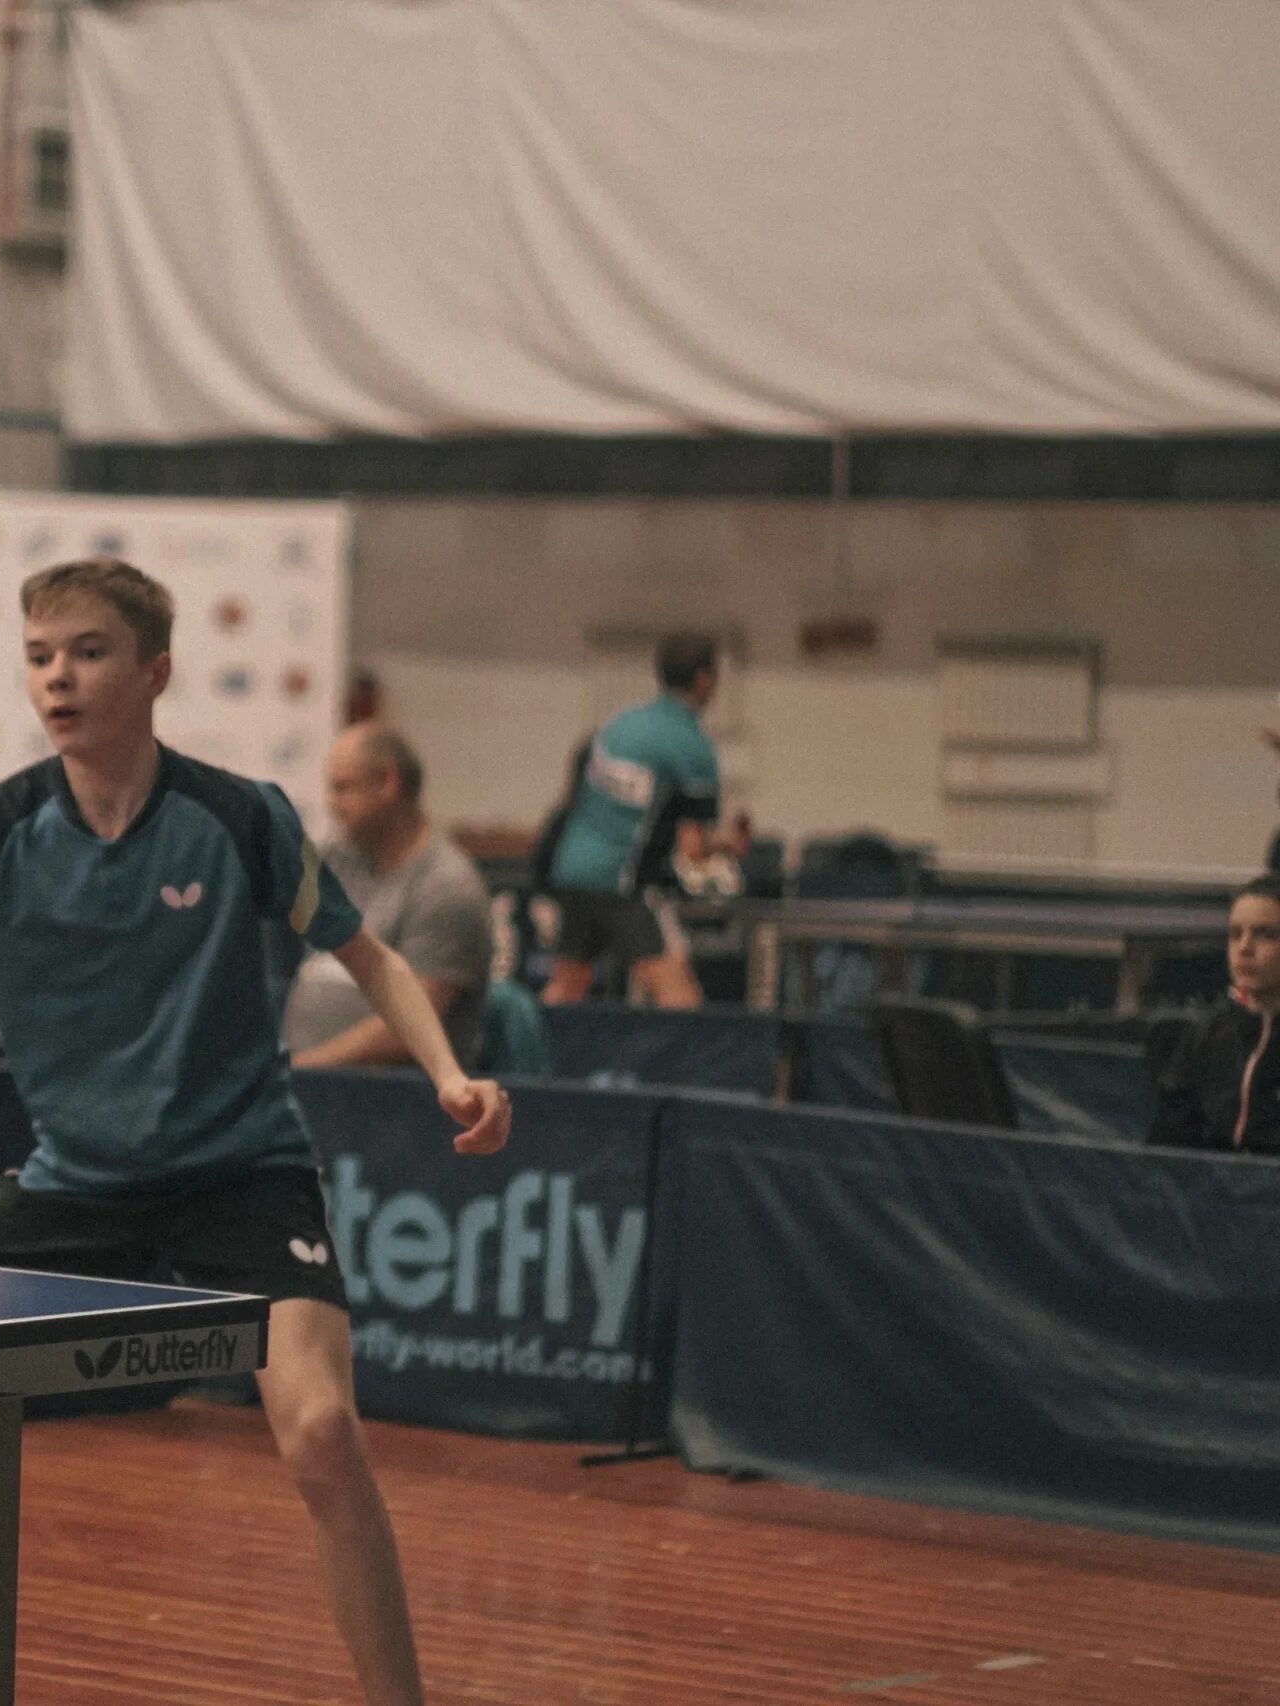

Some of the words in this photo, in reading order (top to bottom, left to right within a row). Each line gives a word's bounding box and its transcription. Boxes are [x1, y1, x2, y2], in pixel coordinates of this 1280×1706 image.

[324, 1154, 646, 1347] terfly
[125, 1329, 237, 1377] Butterfly
[351, 1317, 655, 1382] fly-world.com
